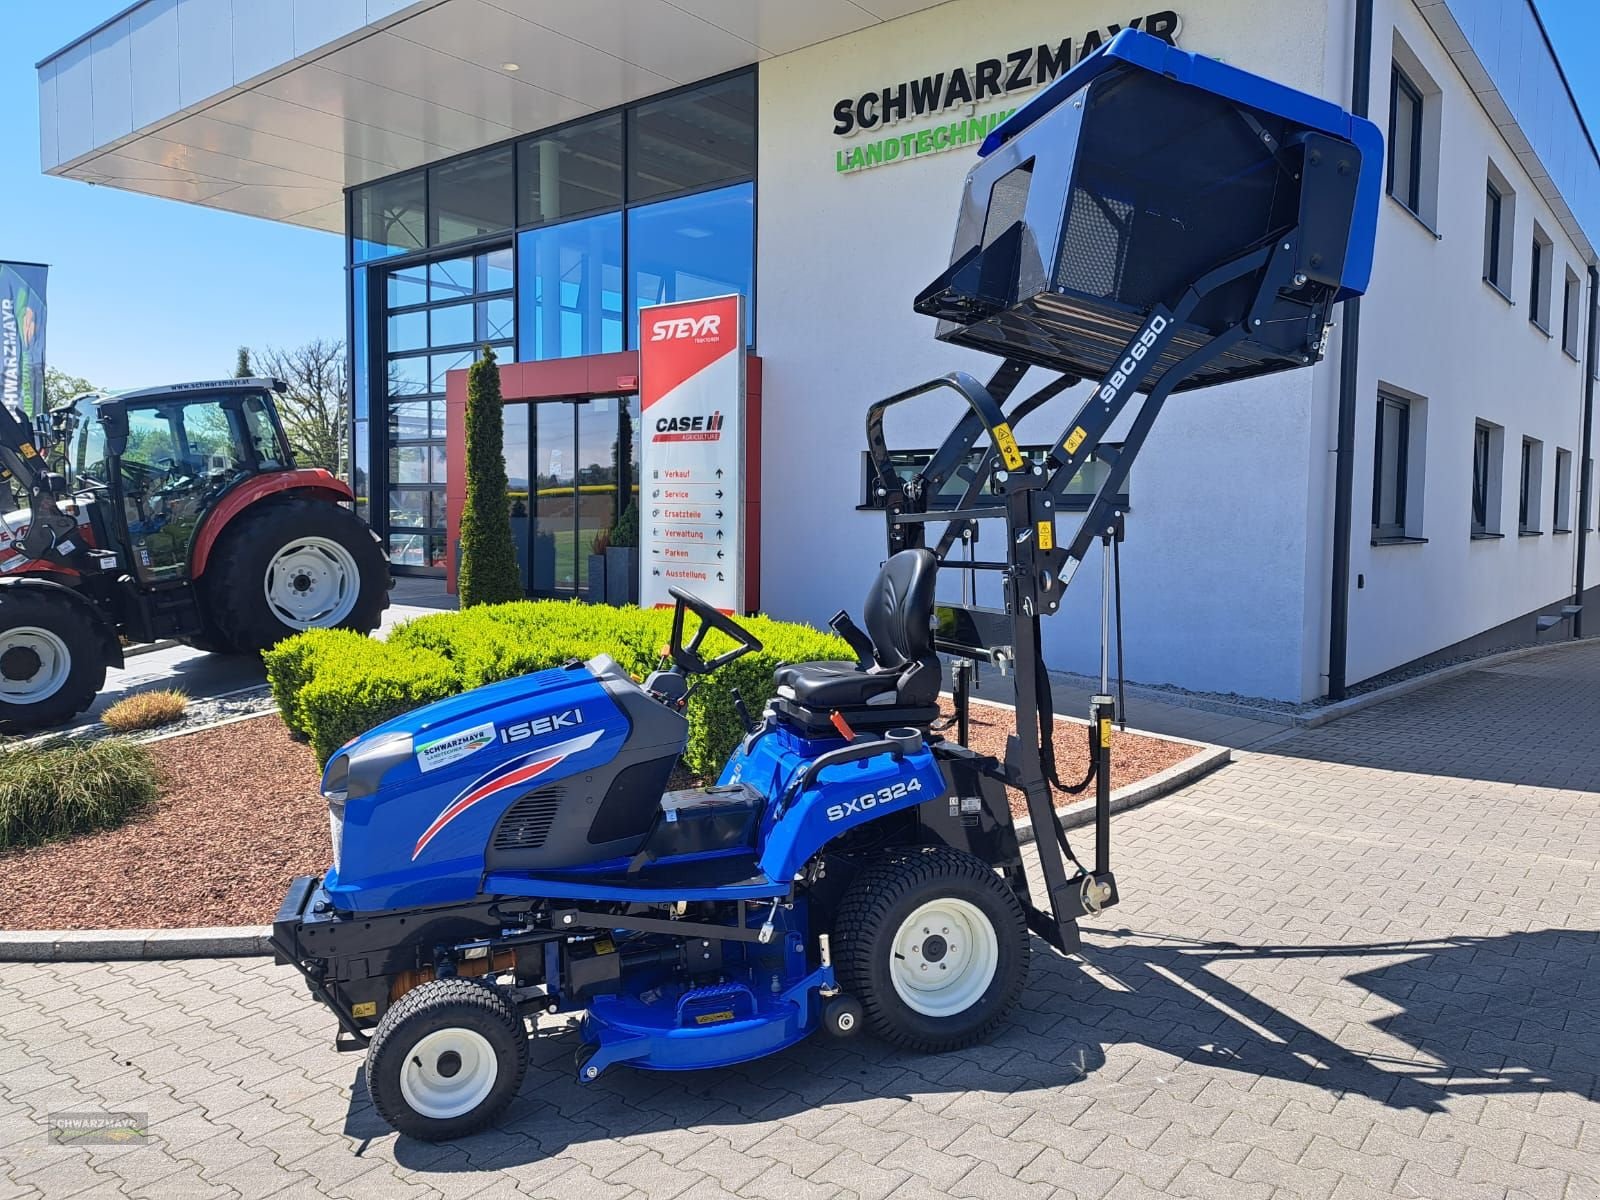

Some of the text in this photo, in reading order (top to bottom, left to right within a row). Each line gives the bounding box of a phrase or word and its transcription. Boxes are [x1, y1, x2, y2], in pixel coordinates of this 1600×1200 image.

[650, 314, 721, 342] STEYR
[1099, 314, 1167, 404] SBC650
[655, 415, 704, 433] CASE
[664, 469, 691, 479] Verkauf
[664, 490, 689, 499] Service
[664, 510, 702, 520] Ersatzteile
[664, 528, 705, 540] Verwaltung
[664, 548, 689, 558] Parken
[665, 569, 708, 581] Ausstellung
[500, 708, 584, 744] ISEKI
[423, 731, 485, 756] SCHWARZMAYR
